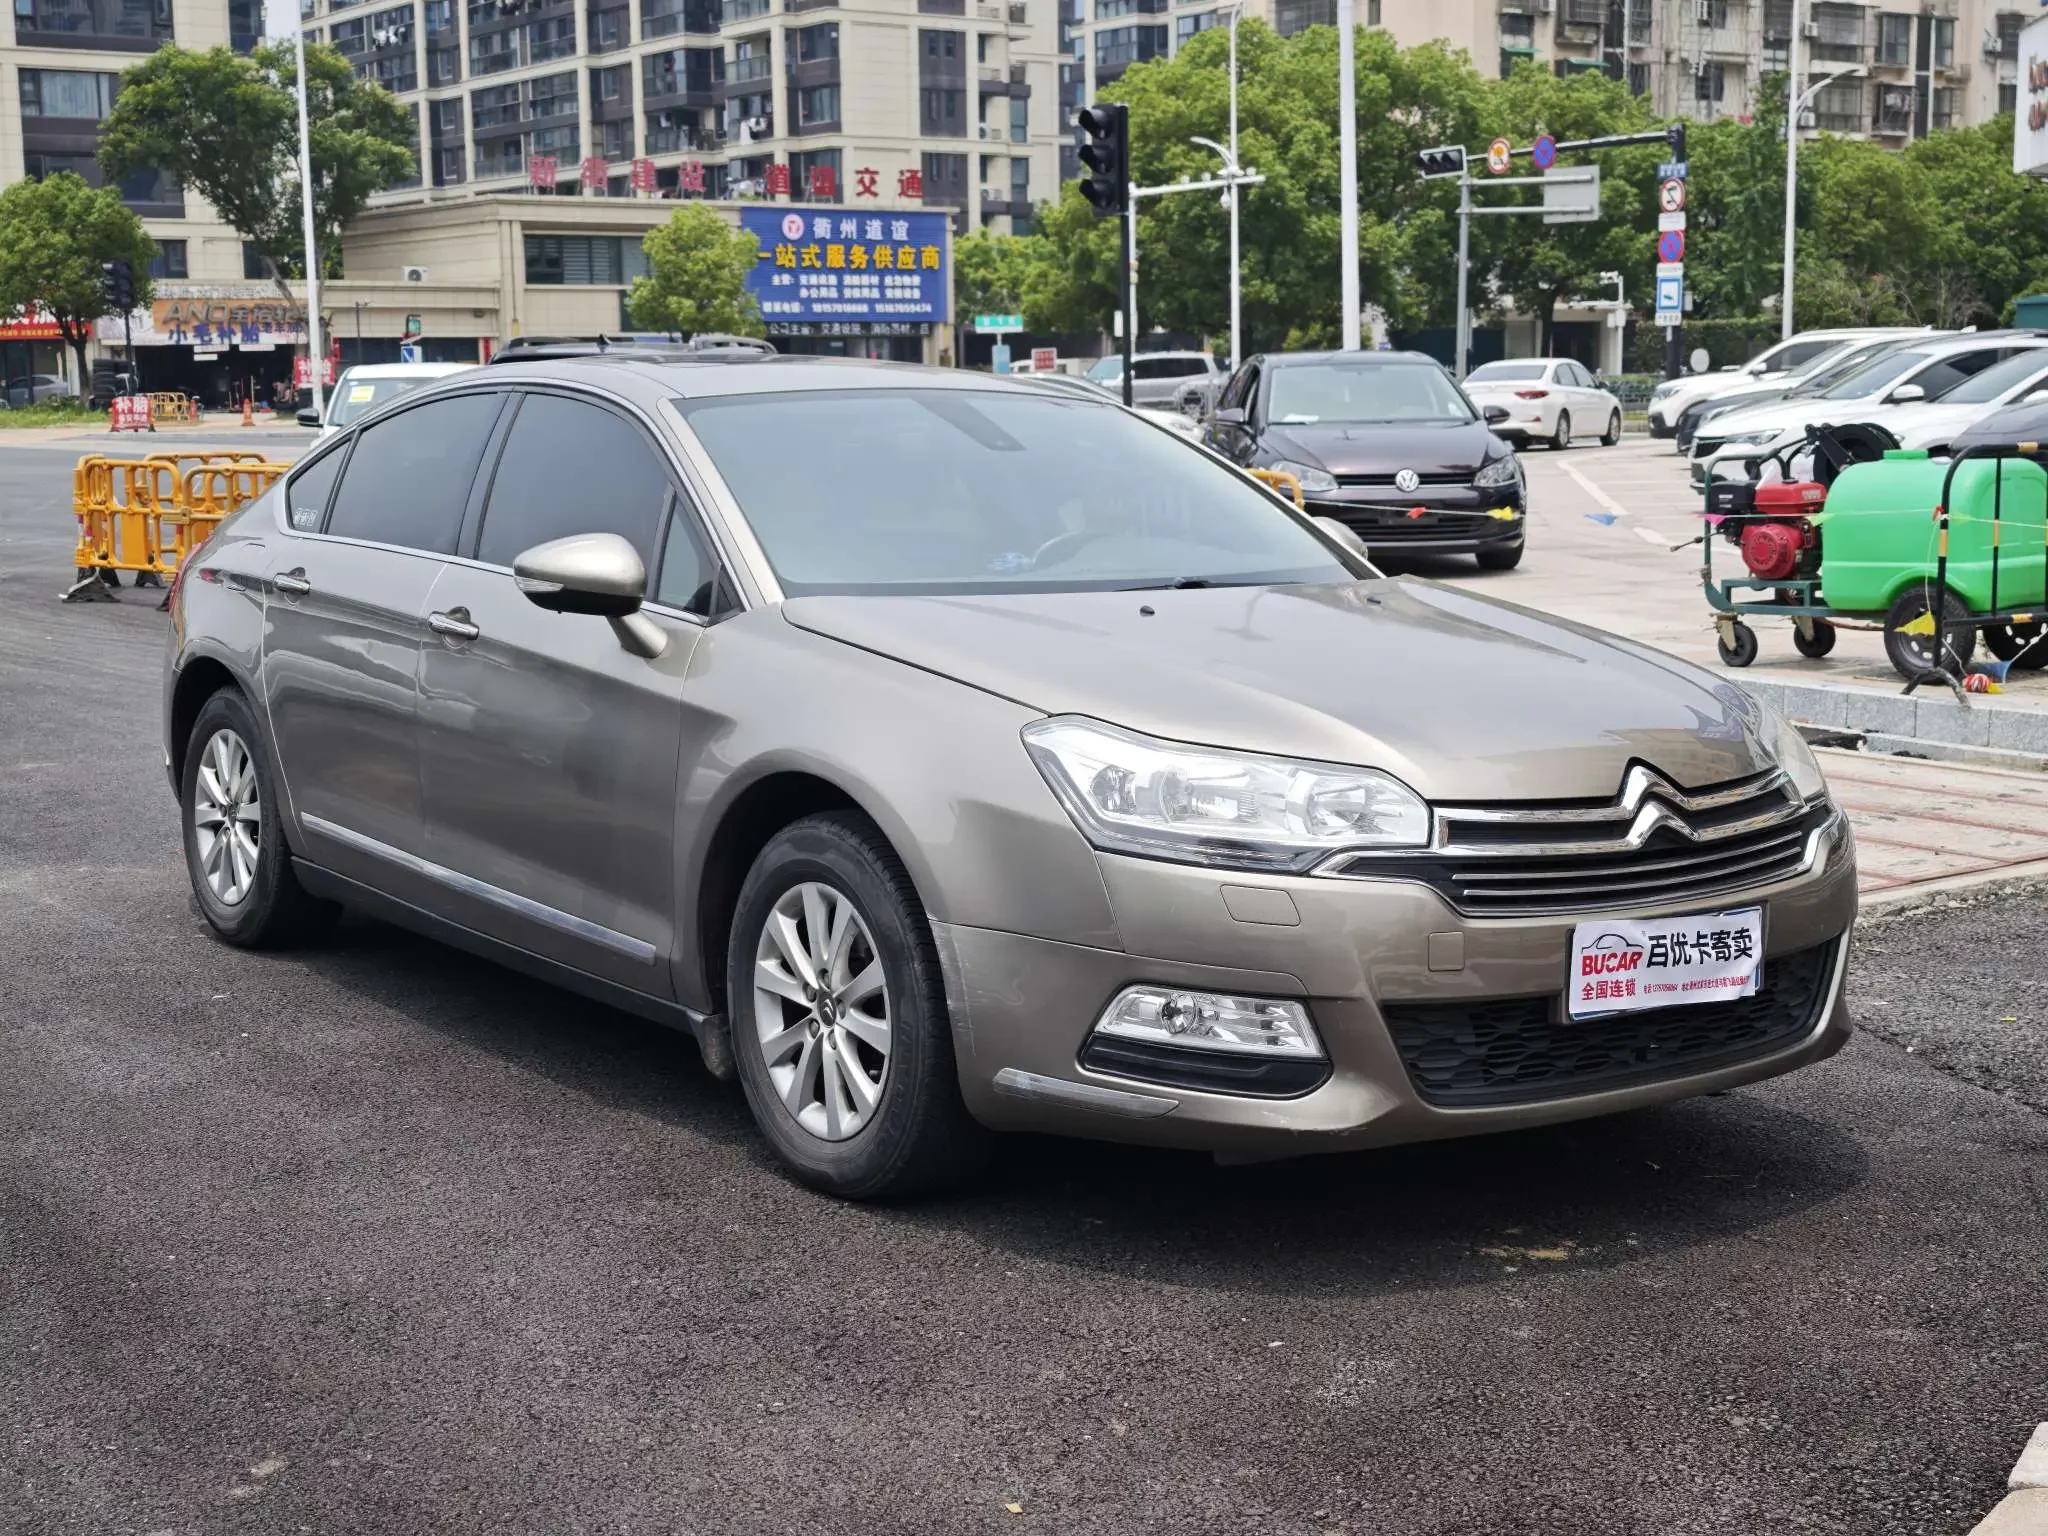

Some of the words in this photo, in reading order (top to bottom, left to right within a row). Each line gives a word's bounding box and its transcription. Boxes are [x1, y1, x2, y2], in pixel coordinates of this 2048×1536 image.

[812, 217, 910, 241] 衢州道谊
[758, 243, 941, 270] 一站式服务供应商
[1646, 926, 1753, 969] 百优卡寄卖
[1581, 950, 1644, 977] BUCAR
[1581, 977, 1637, 1001] 全国连锁
